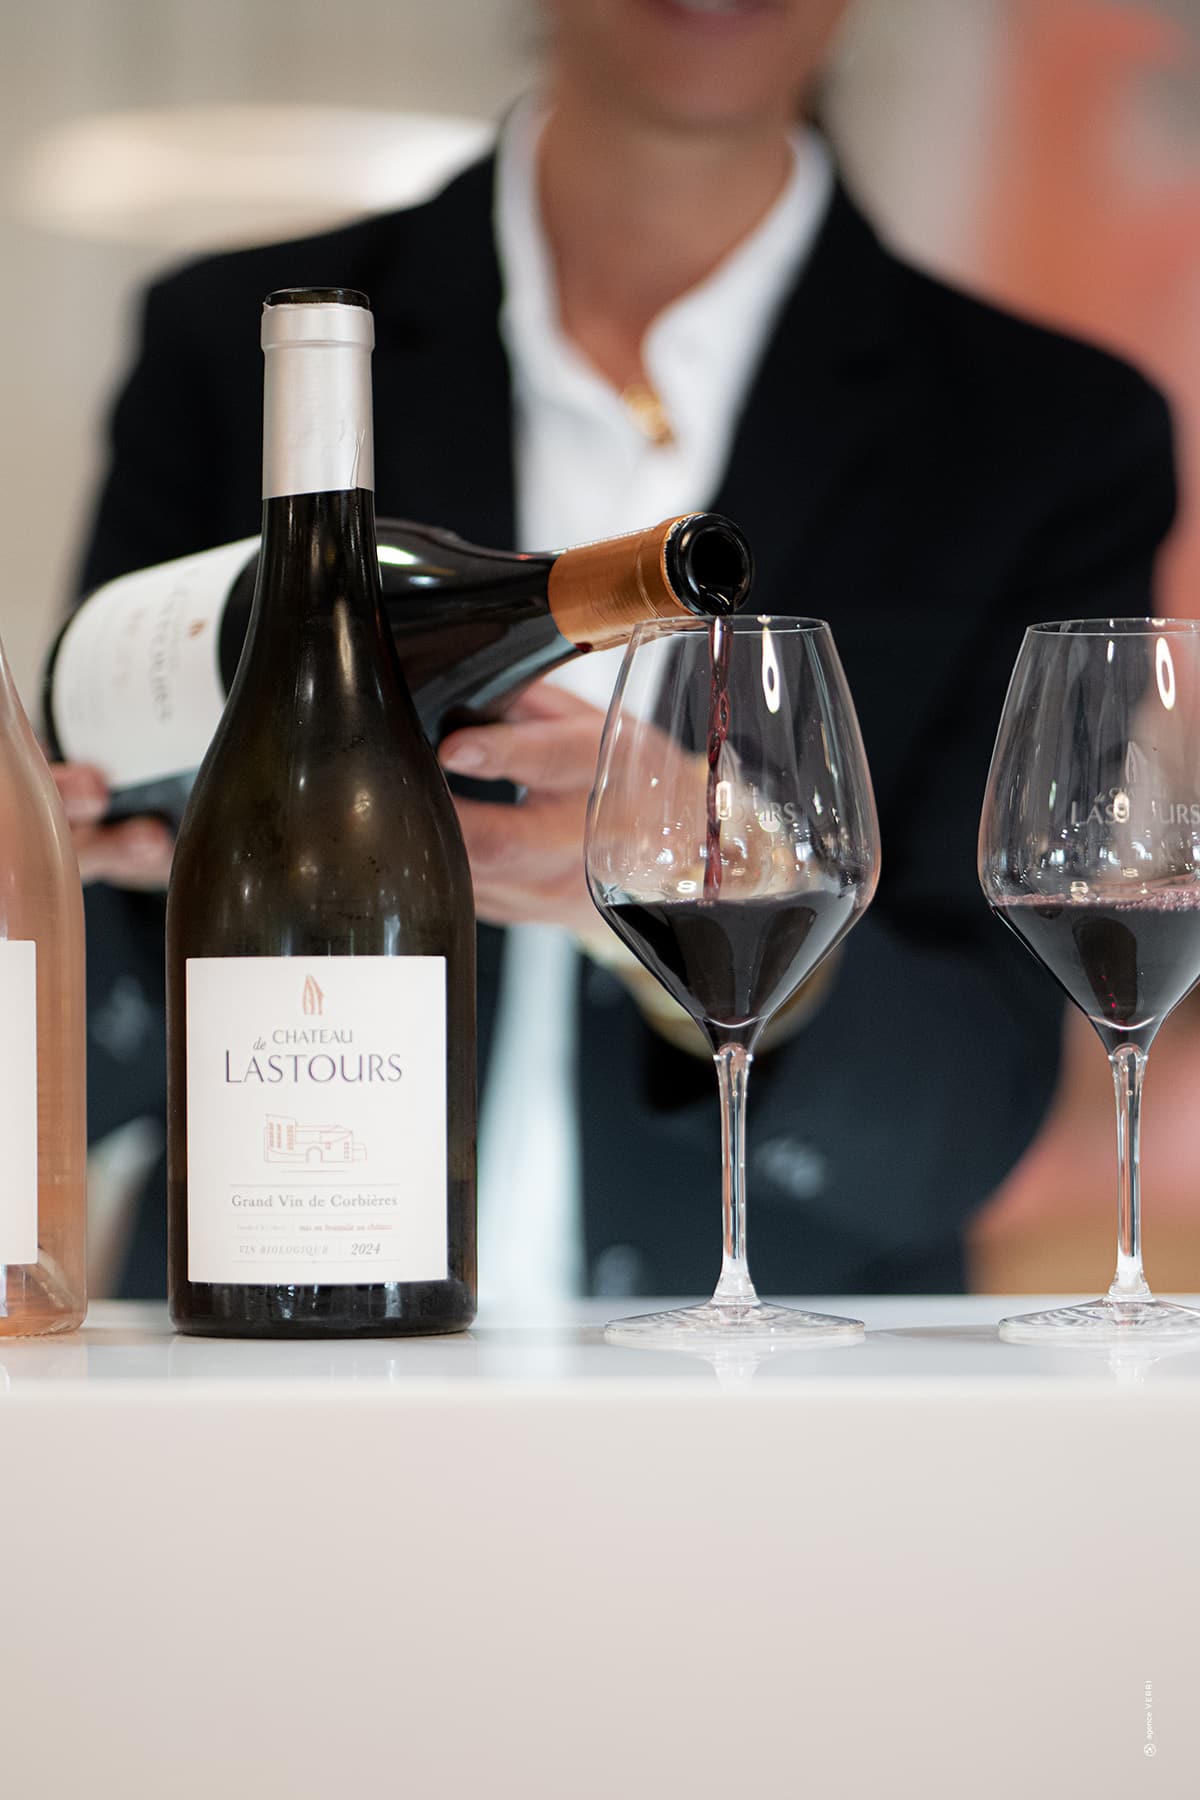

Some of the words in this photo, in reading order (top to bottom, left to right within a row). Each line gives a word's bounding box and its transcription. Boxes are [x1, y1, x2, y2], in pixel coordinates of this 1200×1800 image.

[1071, 800, 1200, 825] LASURS
[252, 1036, 267, 1051] de
[272, 1028, 353, 1044] CHATEAU
[225, 1049, 403, 1084] LASTOURS
[231, 1194, 273, 1208] Grand
[278, 1194, 304, 1208] Vin
[308, 1194, 326, 1208] de
[330, 1193, 398, 1208] Corbières
[239, 1244, 256, 1256] VIN
[351, 1242, 381, 1256] 2024
